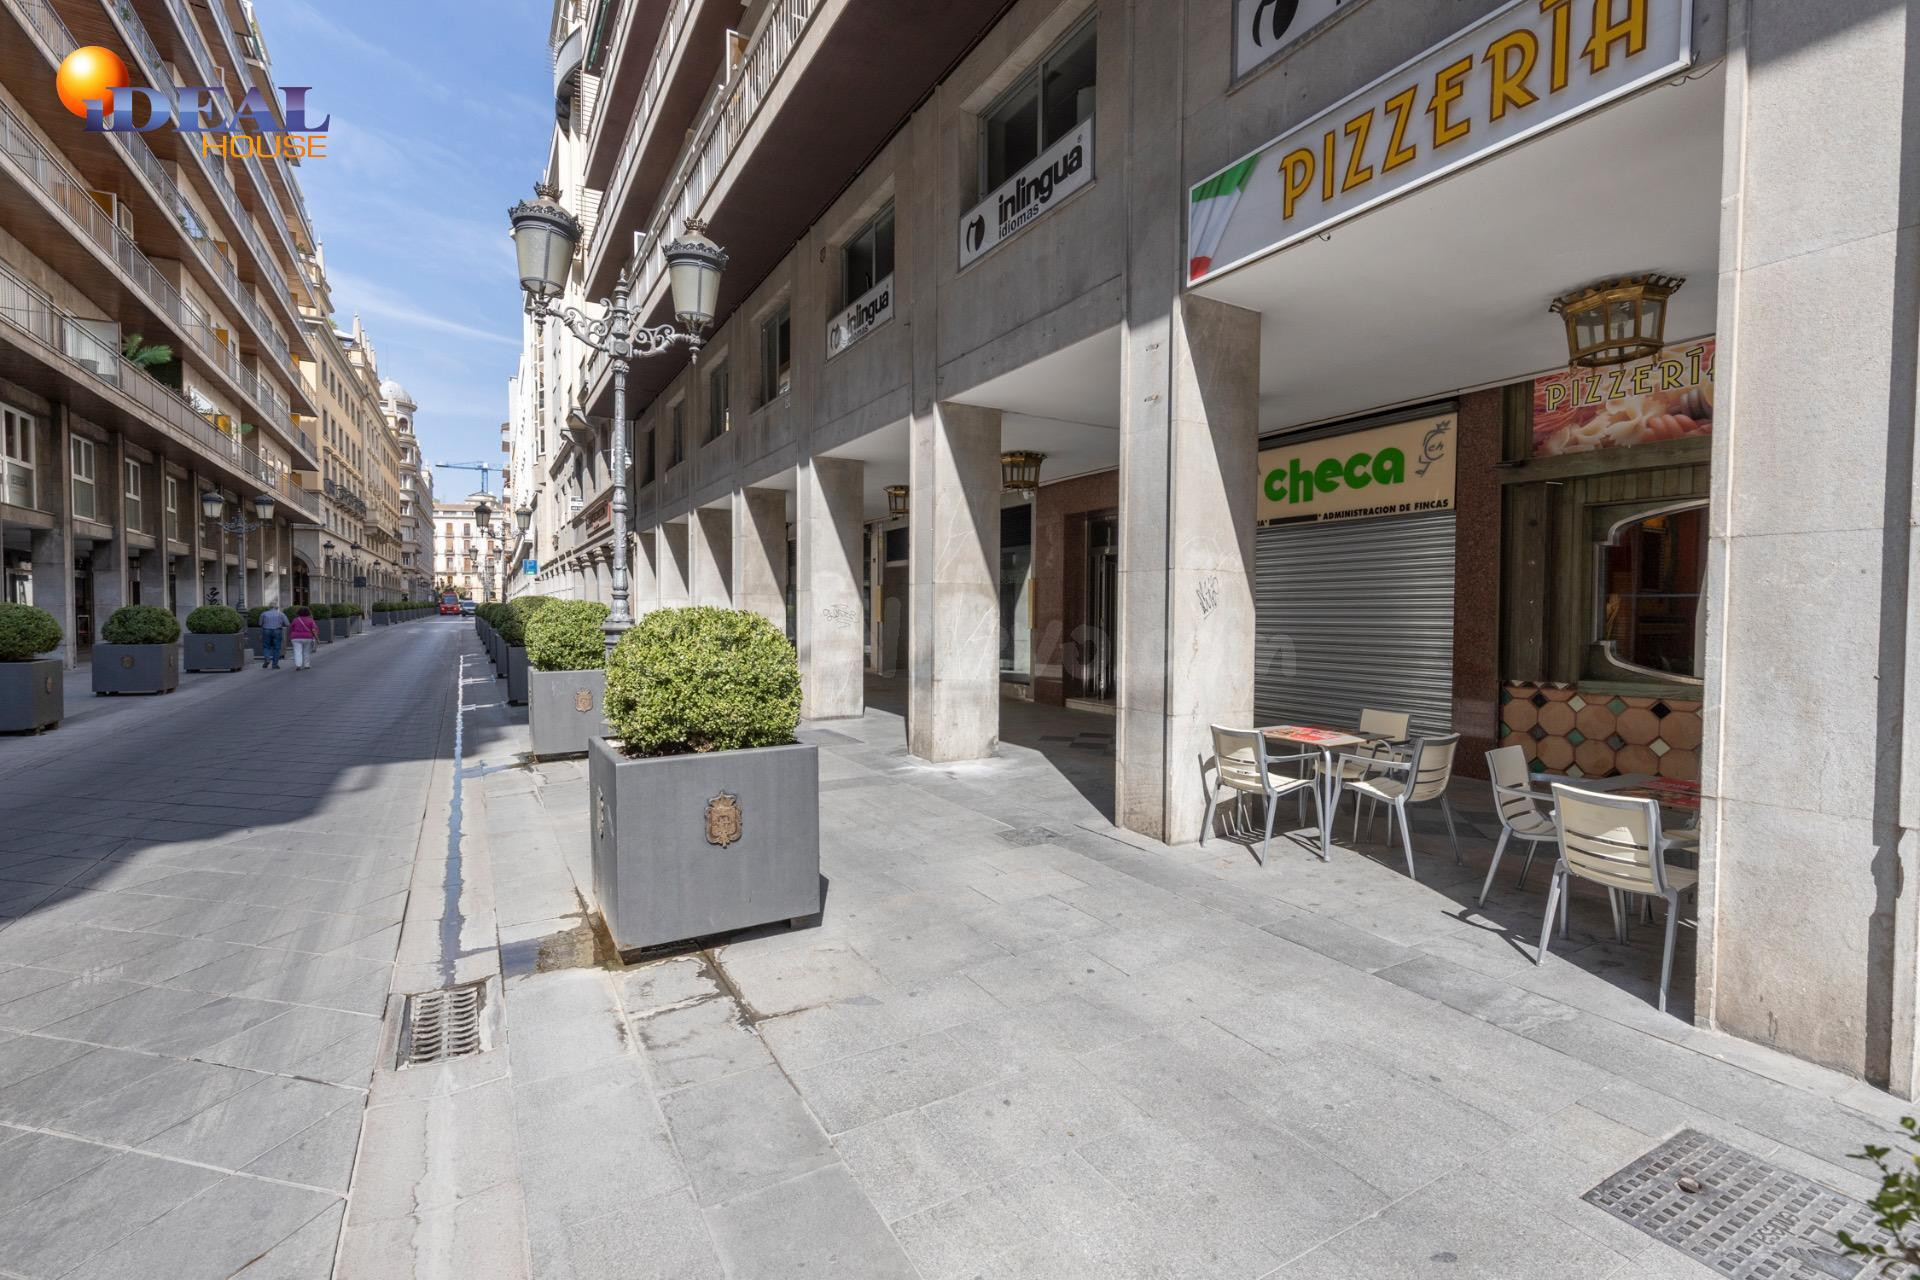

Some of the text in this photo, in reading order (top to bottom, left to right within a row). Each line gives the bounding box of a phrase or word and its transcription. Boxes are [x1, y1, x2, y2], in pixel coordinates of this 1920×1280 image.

[998, 145, 1083, 225] inlingua
[998, 203, 1039, 239] idiomas
[847, 290, 889, 332] inlingua
[1546, 346, 1716, 411] PIZZERÍ
[1264, 447, 1405, 504] checa
[1323, 499, 1449, 520] ADMINISTRACION DE FINCAS
